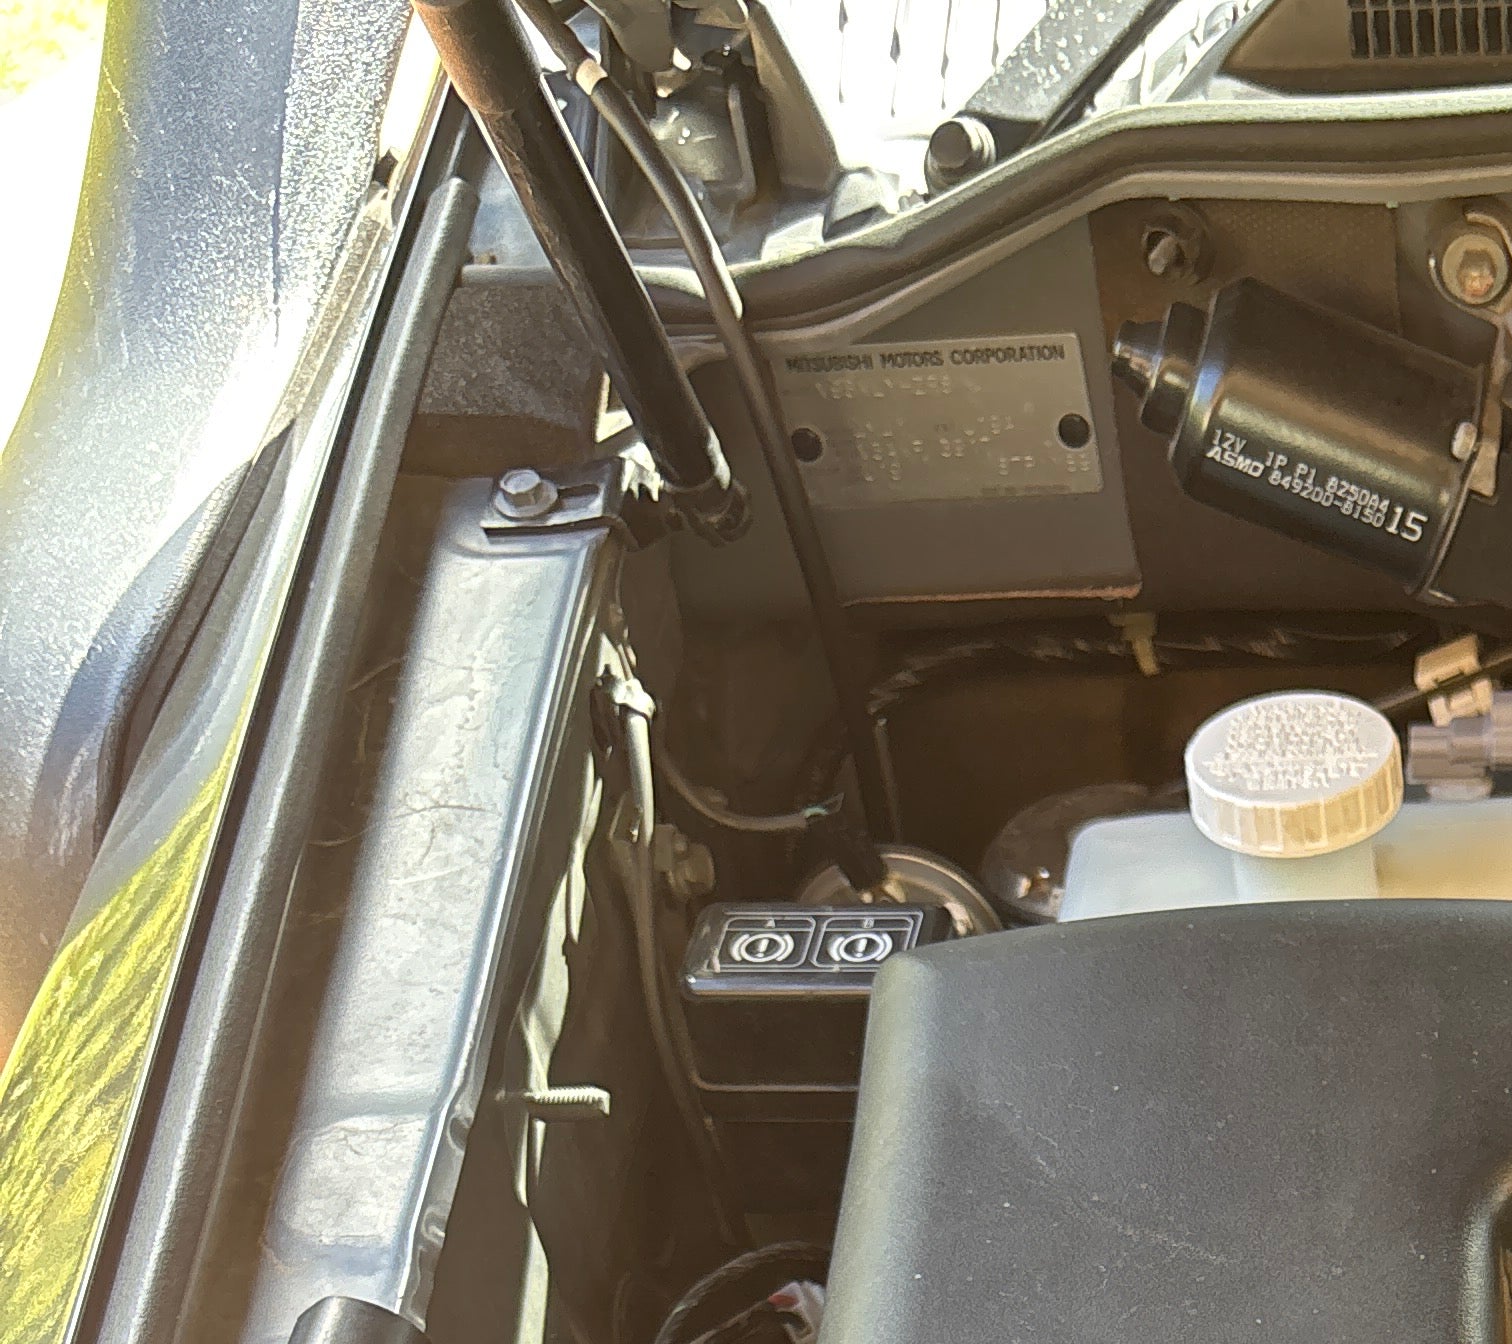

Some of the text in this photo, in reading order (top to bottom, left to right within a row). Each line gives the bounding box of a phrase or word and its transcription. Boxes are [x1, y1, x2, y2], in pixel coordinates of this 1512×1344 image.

[785, 344, 1065, 373] MITSUBISHI MOTORS CORPORATION
[1211, 428, 1247, 454] 12V
